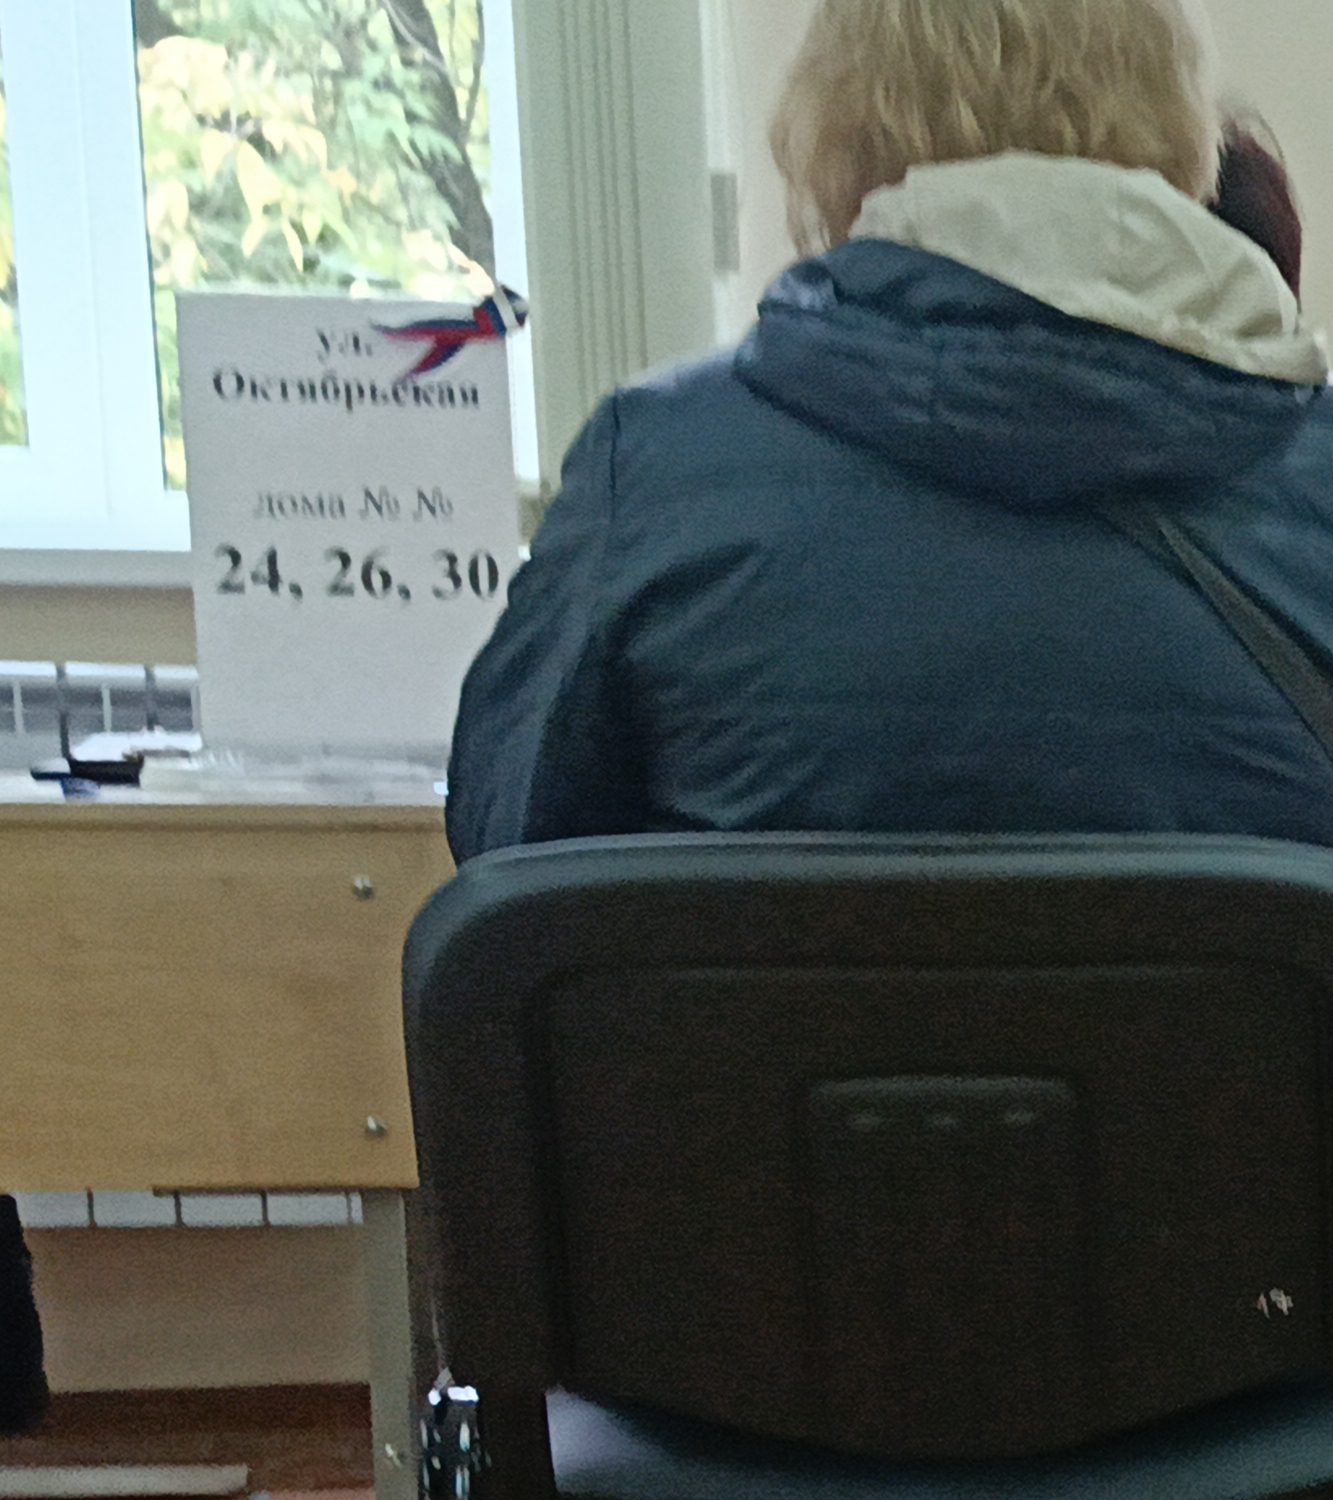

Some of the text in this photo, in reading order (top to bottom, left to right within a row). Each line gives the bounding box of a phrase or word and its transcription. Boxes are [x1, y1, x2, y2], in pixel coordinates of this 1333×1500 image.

[212, 365, 479, 411] Октябрьская
[253, 490, 345, 520] дома
[214, 542, 499, 600] 24, 26, 30
